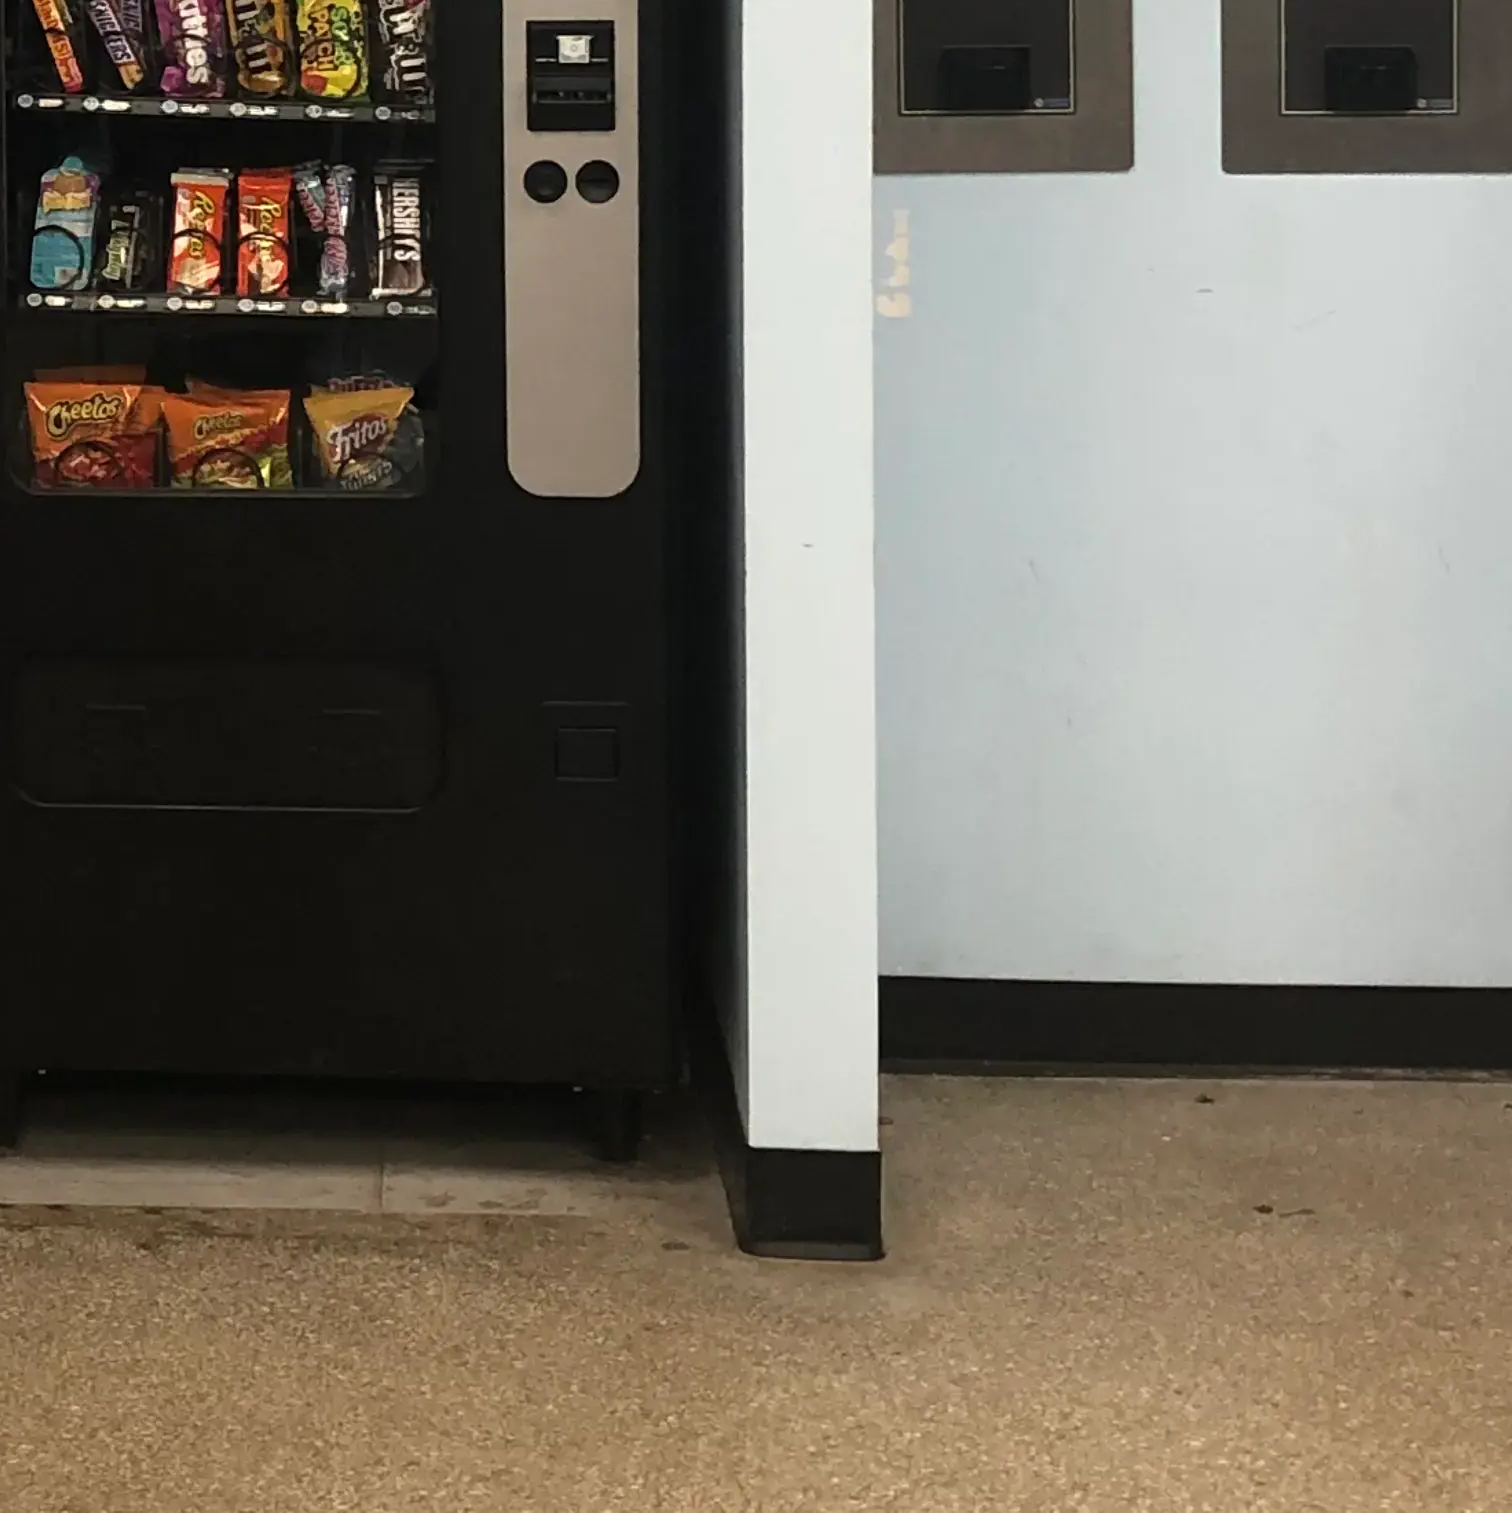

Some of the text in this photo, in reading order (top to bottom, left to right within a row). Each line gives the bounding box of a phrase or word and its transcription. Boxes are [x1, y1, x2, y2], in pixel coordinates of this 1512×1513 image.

[330, 6, 355, 66] SOR
[46, 393, 123, 438] Cheetos
[326, 419, 387, 462] Fritos
